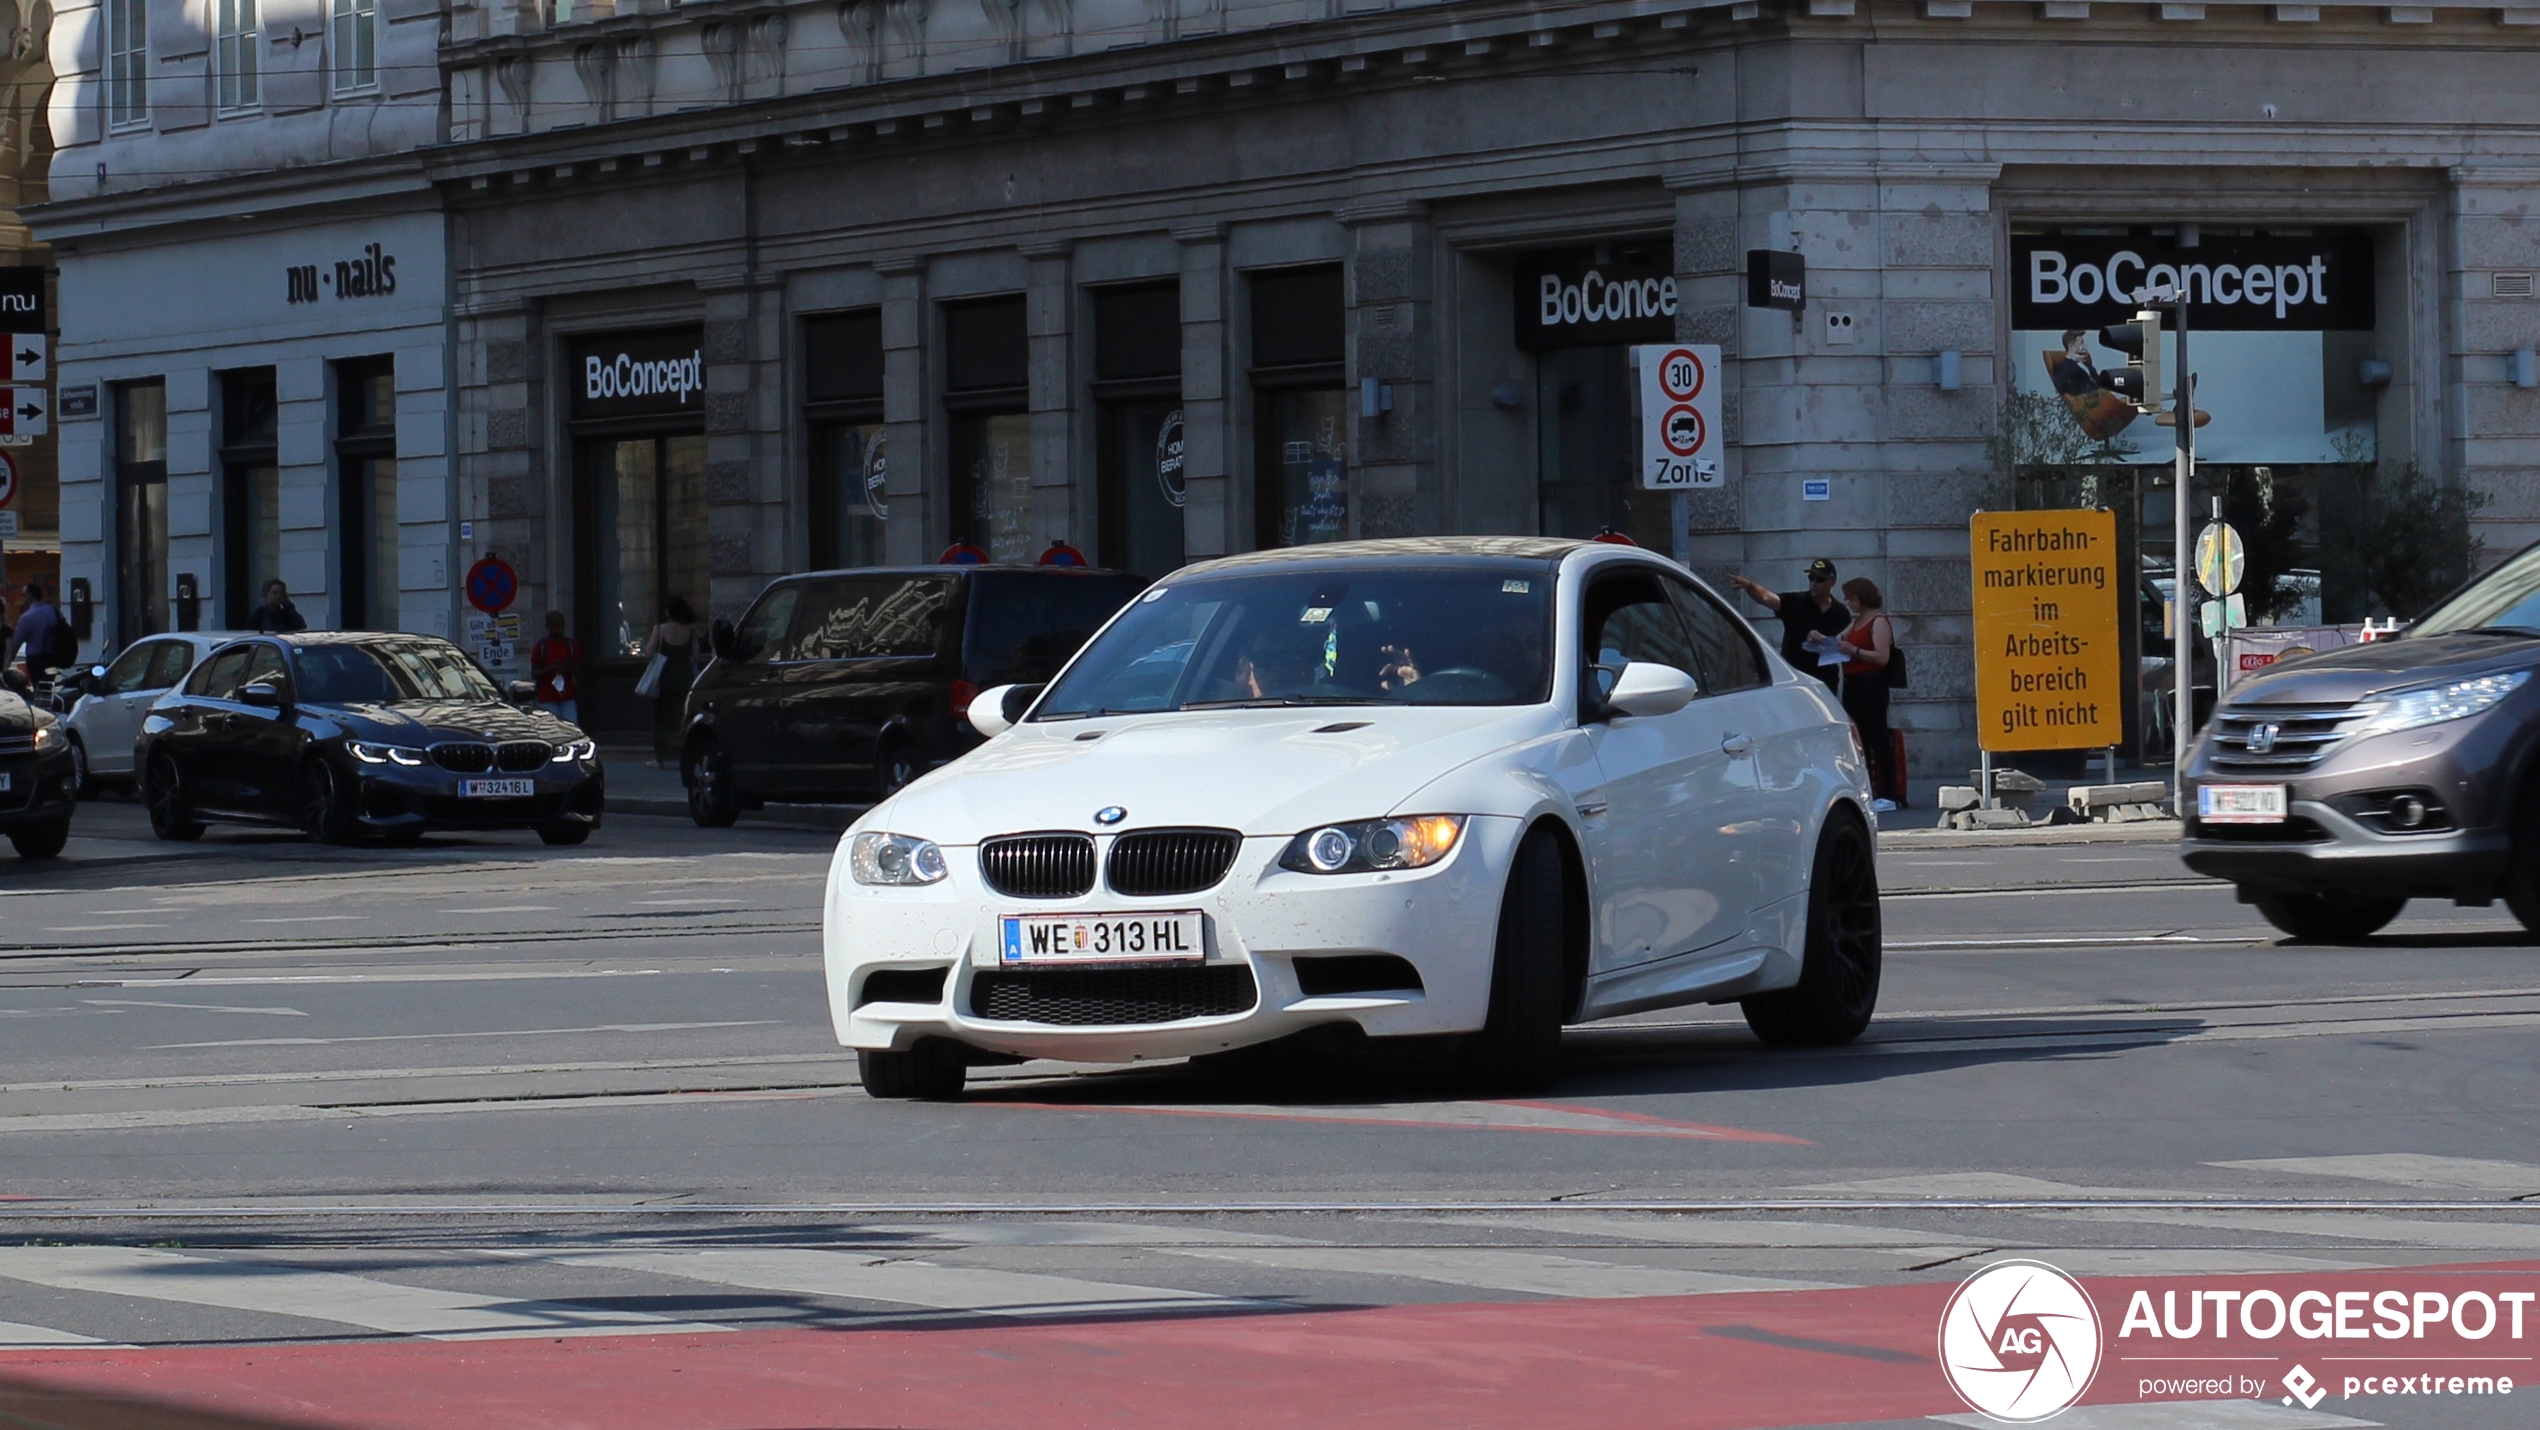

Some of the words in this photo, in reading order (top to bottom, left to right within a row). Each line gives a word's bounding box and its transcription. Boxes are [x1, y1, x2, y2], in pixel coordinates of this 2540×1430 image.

[286, 265, 318, 304] nu
[334, 242, 396, 299] nails
[2030, 250, 2328, 319] BoConcept
[1541, 270, 1678, 325] BoConce
[1771, 279, 1801, 303] BoConcept
[586, 349, 702, 404] BoConcept
[1671, 364, 1692, 388] 30
[1989, 527, 2098, 552] Fahrbahn-
[1984, 562, 2105, 590] markierung
[2033, 596, 2059, 621] im
[483, 646, 510, 660] Ende
[2005, 631, 2089, 658] Arbeits-
[2010, 666, 2087, 693] bereich
[2003, 702, 2039, 734] gilt
[2045, 701, 2098, 726] nicht
[469, 781, 479, 794] W
[1029, 923, 1069, 955] WE
